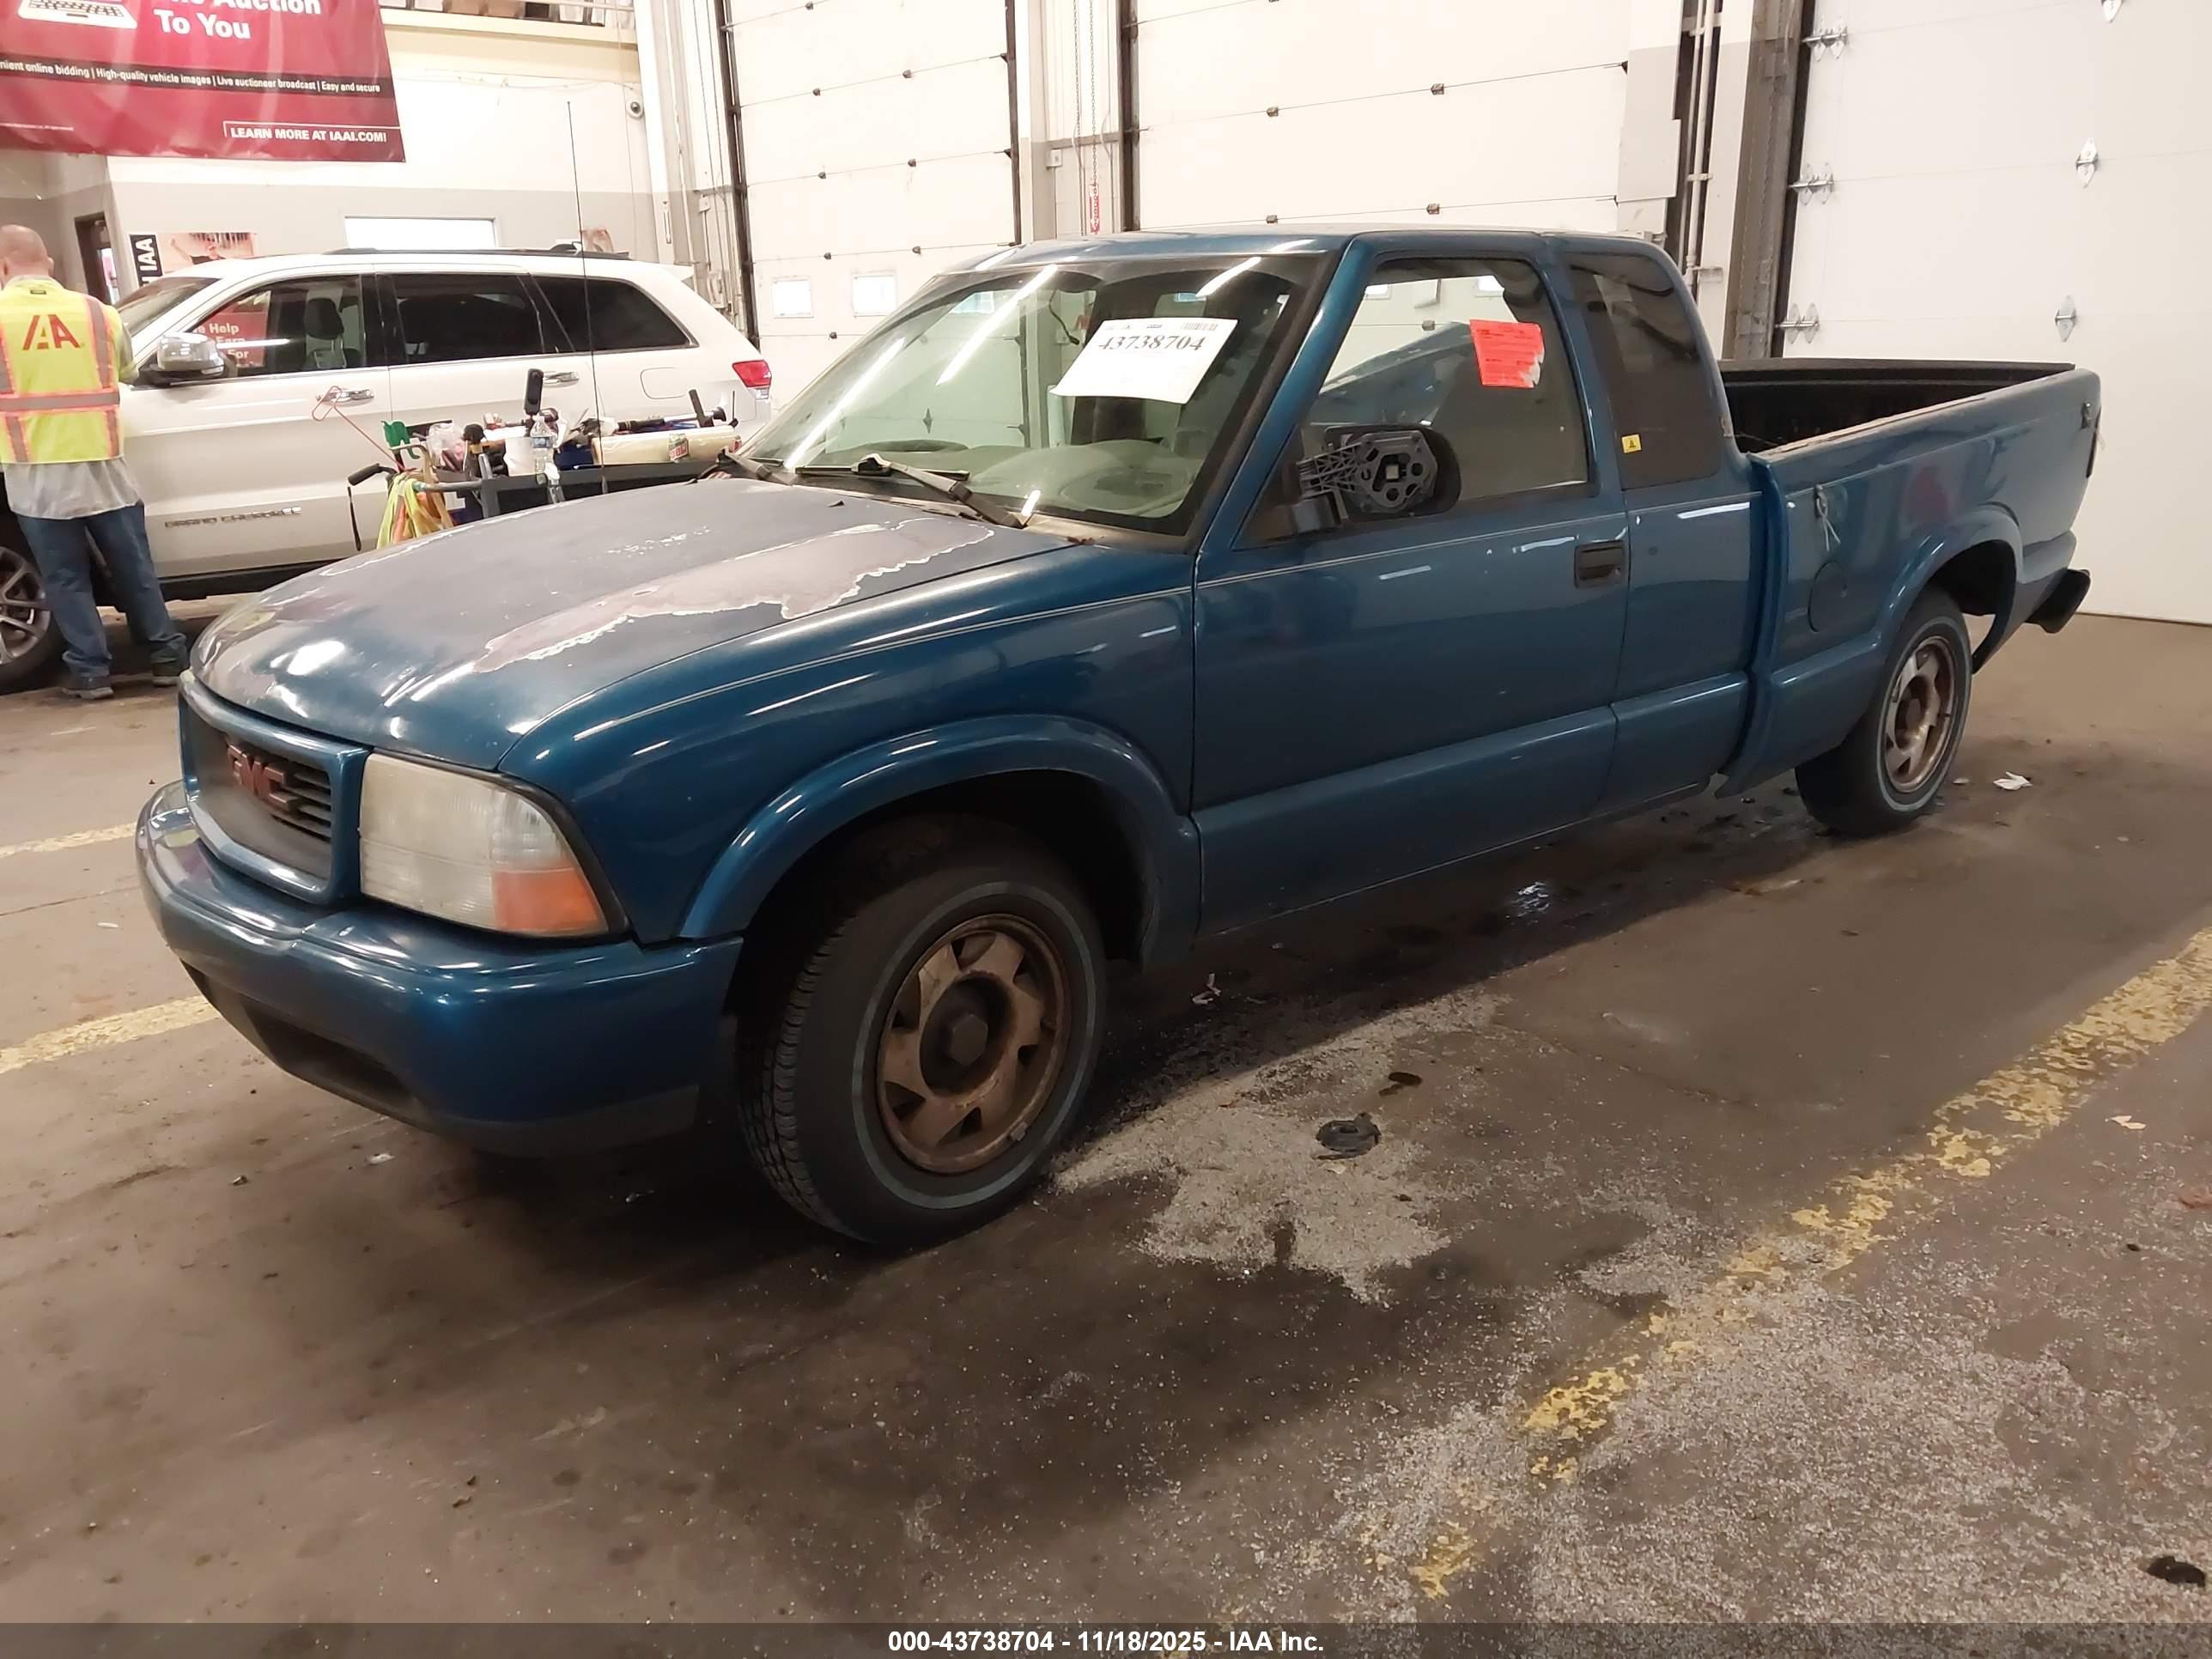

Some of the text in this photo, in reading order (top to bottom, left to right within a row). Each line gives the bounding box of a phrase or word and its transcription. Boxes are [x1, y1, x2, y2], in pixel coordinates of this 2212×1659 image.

[153, 9, 252, 40] To You
[25, 63, 54, 75] online
[55, 64, 89, 79] bidding
[97, 68, 149, 82] High-quality
[149, 72, 179, 84] vehicle
[180, 75, 211, 87] images
[217, 75, 234, 86] Live
[235, 77, 276, 88] auctioneer
[278, 79, 316, 91] broadcast
[322, 81, 339, 94] Easy
[341, 82, 356, 92] and
[356, 84, 381, 94] secure
[230, 127, 272, 139] LEARN
[275, 128, 310, 141] MORE
[312, 130, 326, 141] AT
[135, 238, 158, 272] IAA
[209, 323, 240, 335] Help
[1098, 334, 1206, 351] 43738704
